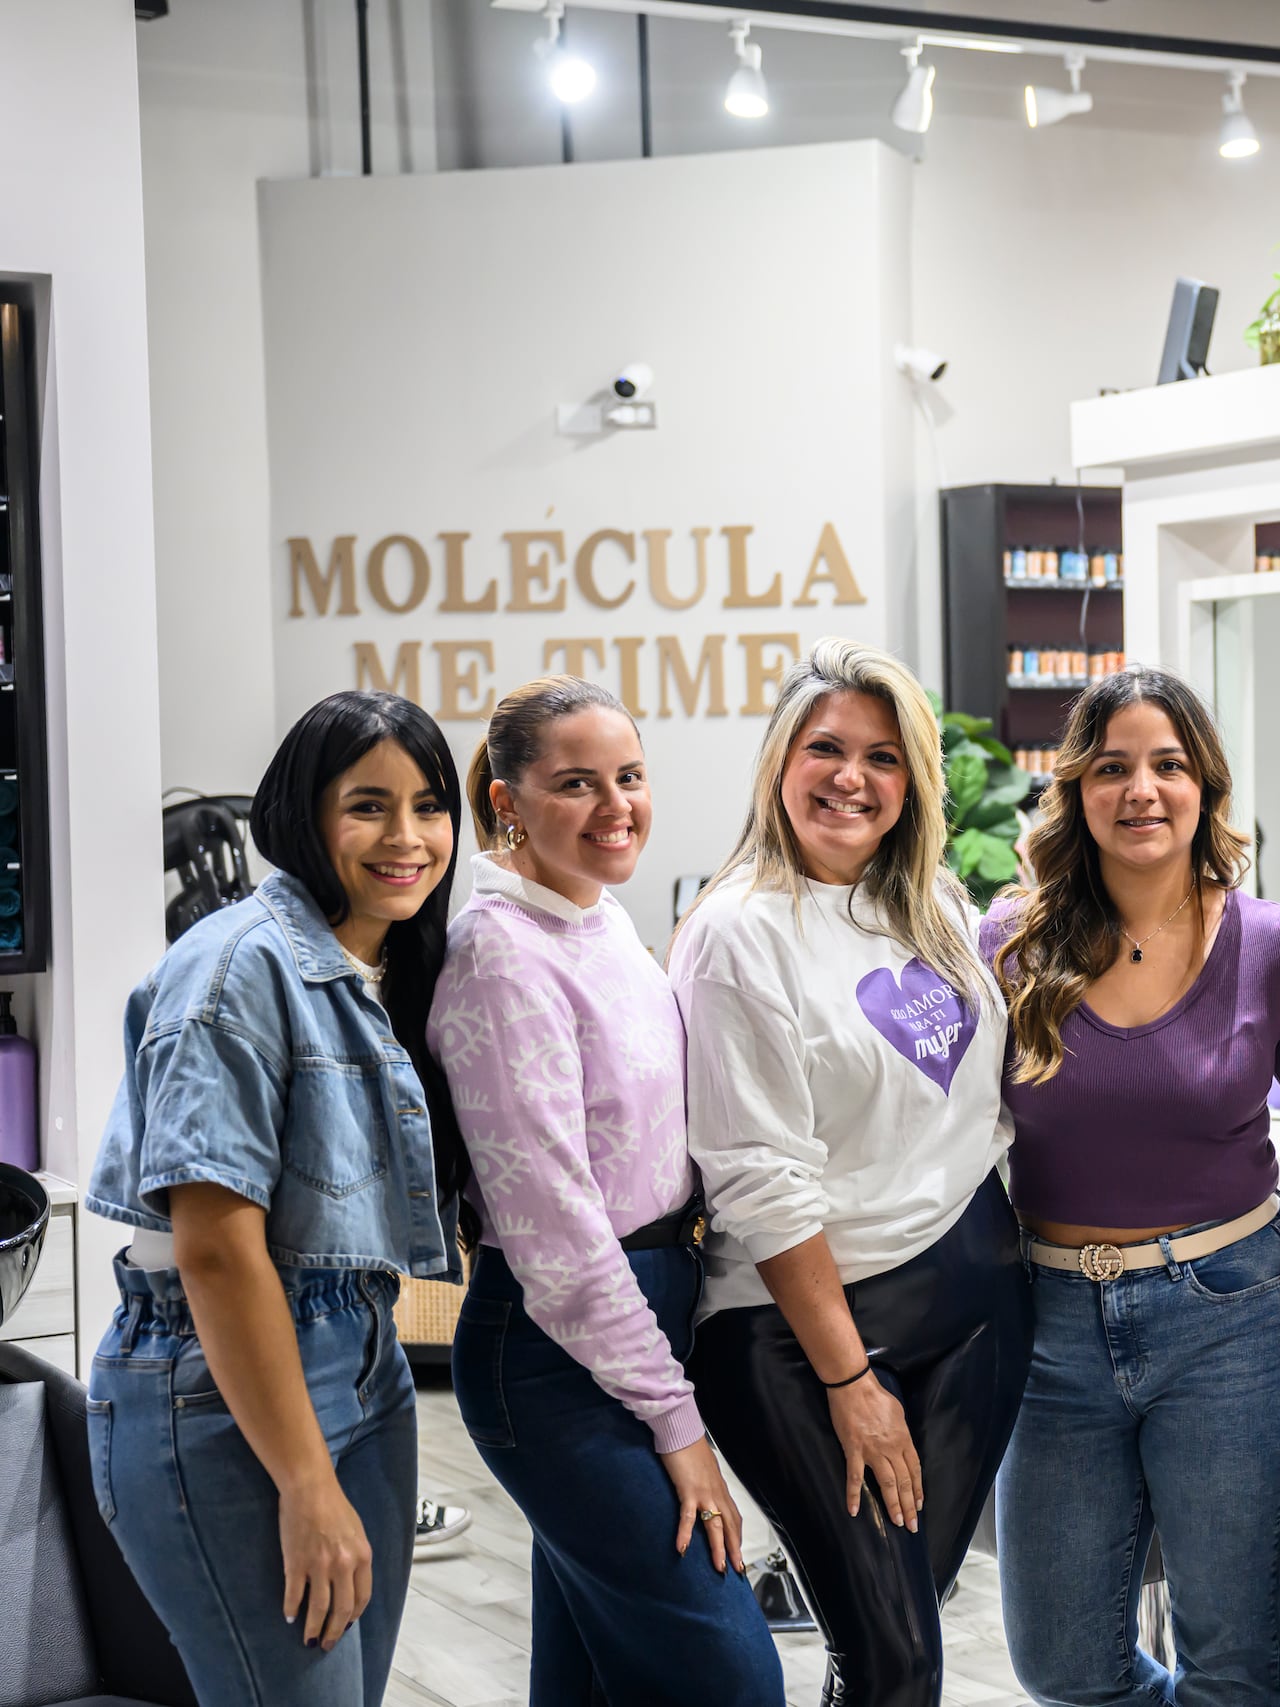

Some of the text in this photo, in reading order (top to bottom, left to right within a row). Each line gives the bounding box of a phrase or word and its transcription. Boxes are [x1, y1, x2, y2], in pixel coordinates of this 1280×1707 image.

[287, 505, 867, 618] MOLÉCULA
[352, 640, 496, 721] ME
[905, 984, 960, 1019] AMOR
[930, 1009, 946, 1021] TI
[914, 1021, 963, 1060] mujer
